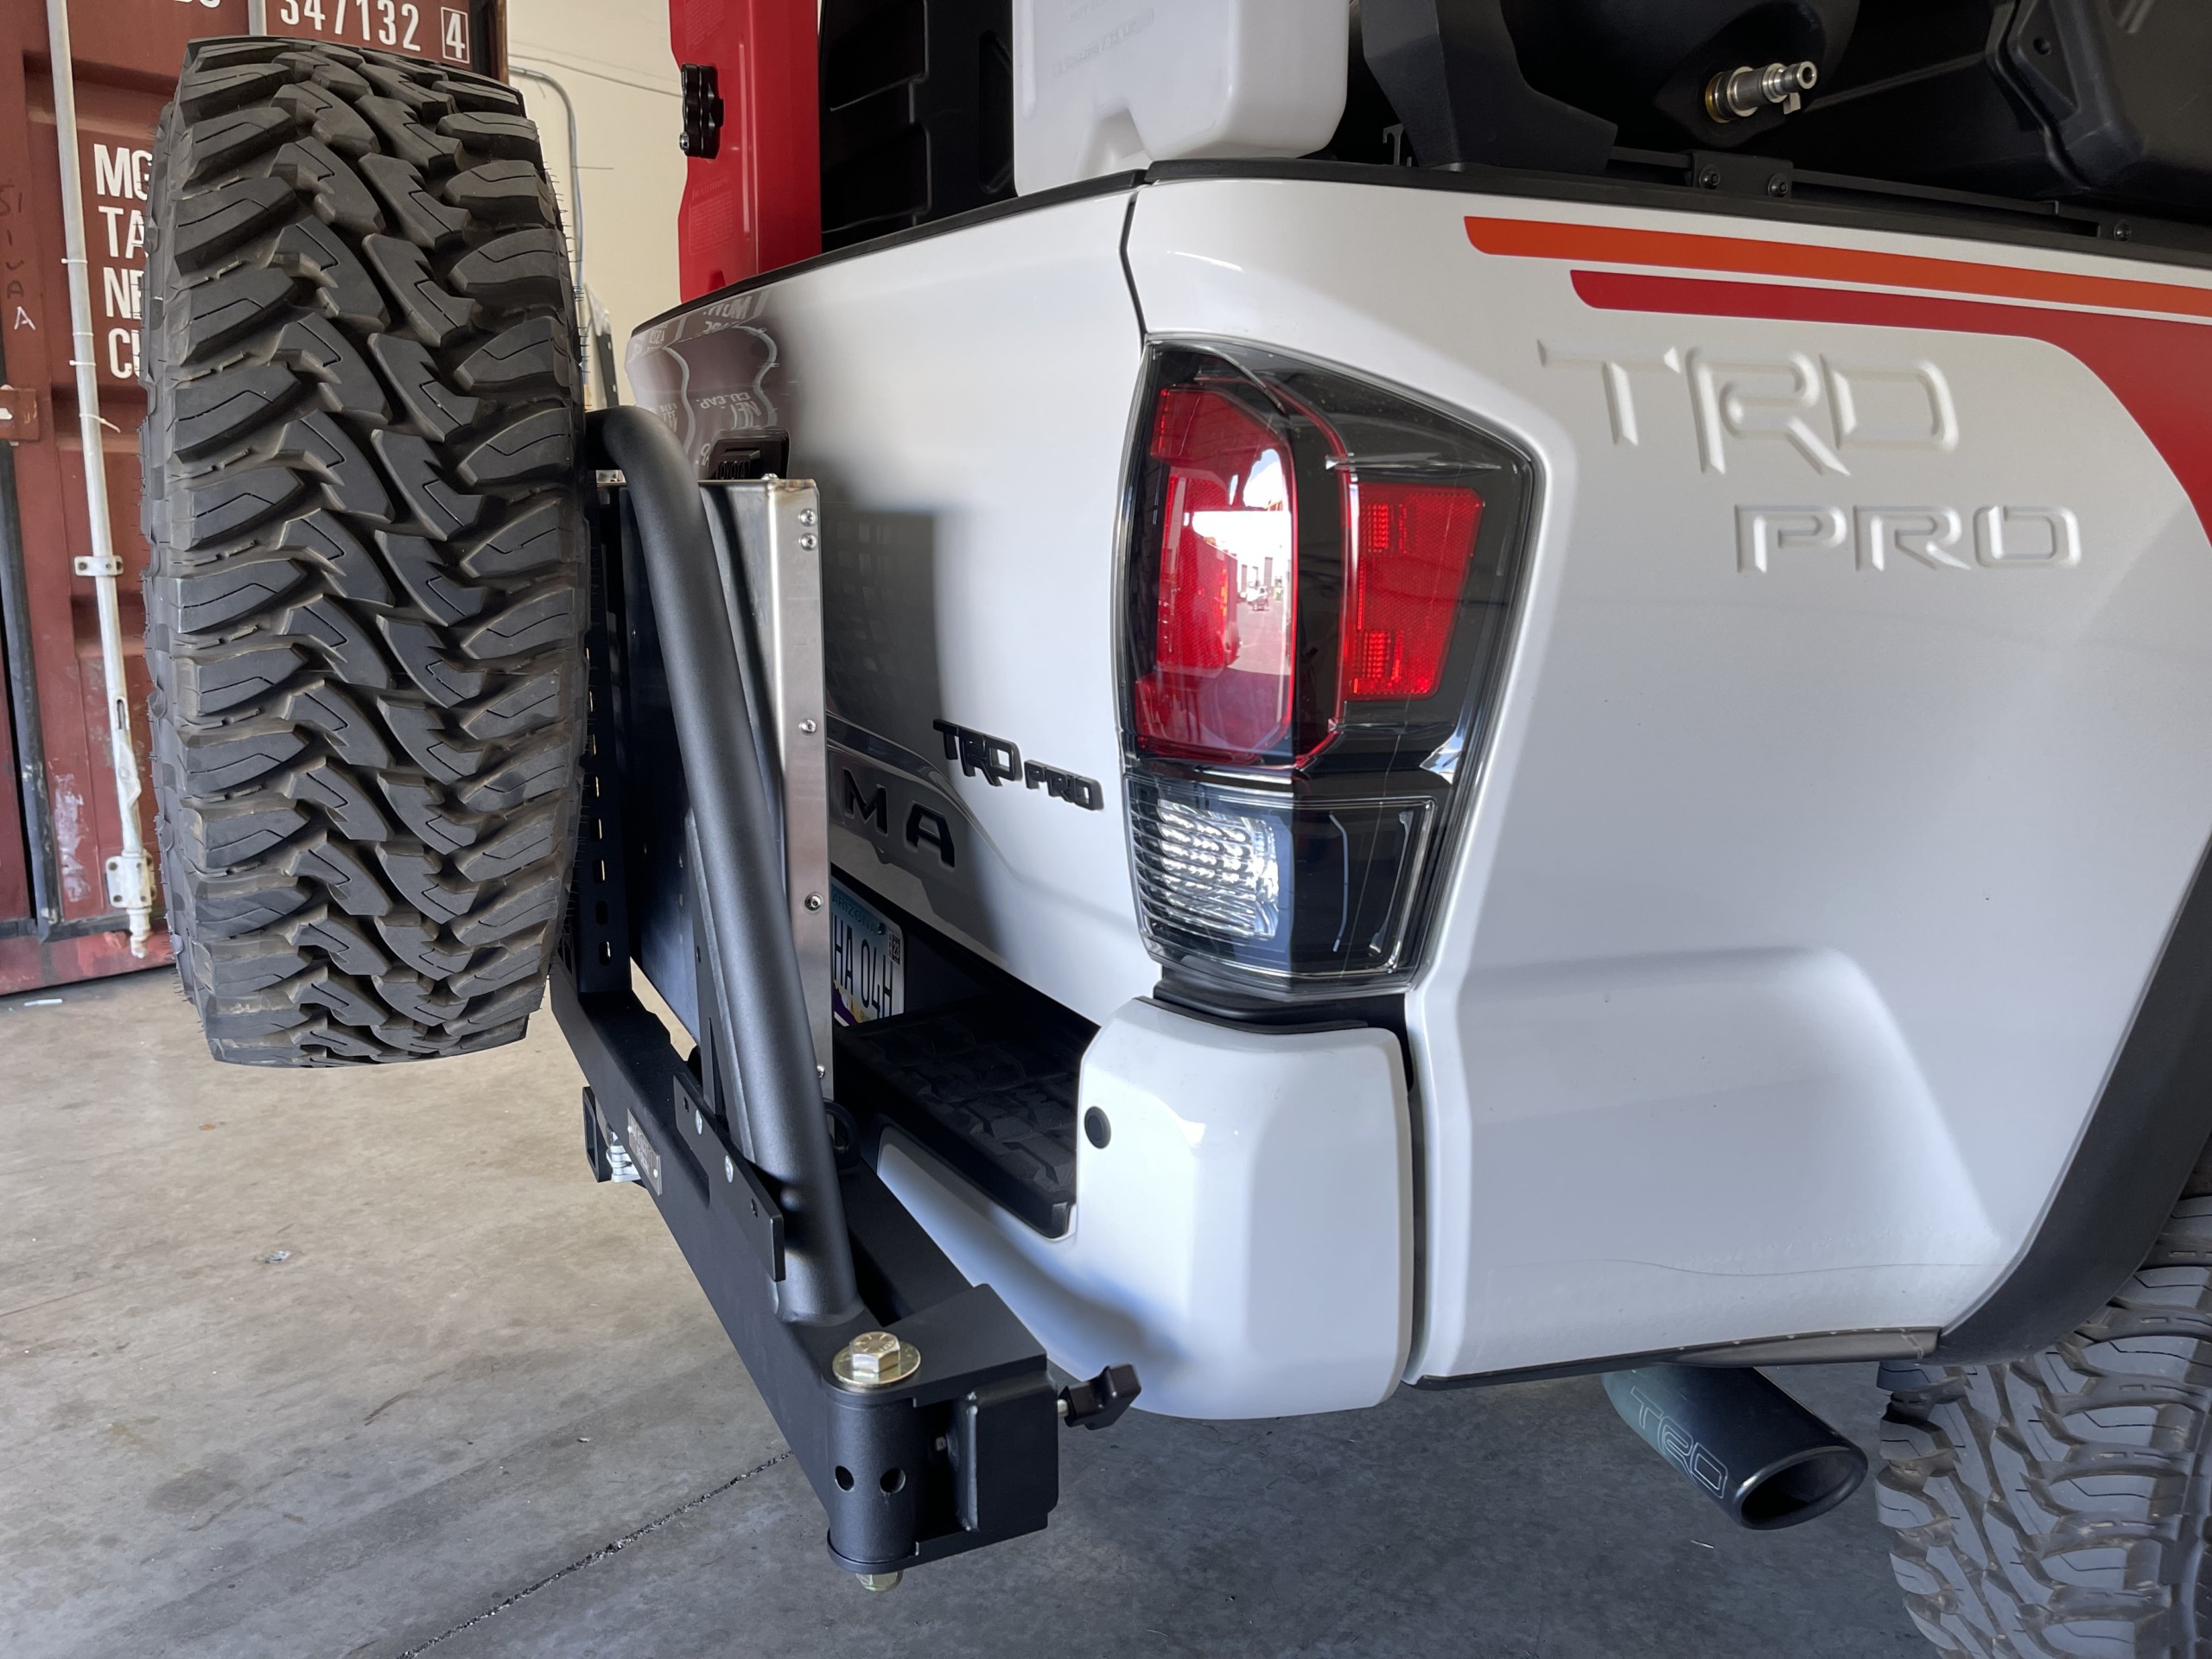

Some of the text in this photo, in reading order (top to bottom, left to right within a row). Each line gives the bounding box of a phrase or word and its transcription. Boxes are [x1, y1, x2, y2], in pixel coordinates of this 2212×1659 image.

[445, 12, 466, 59] 4
[14, 306, 36, 330] A
[1537, 339, 1960, 477] TRD
[1734, 504, 2082, 574] PRO
[933, 718, 1104, 811] TRD PRO
[832, 893, 878, 935] ARIZONA
[1630, 1385, 1727, 1499] TRD
